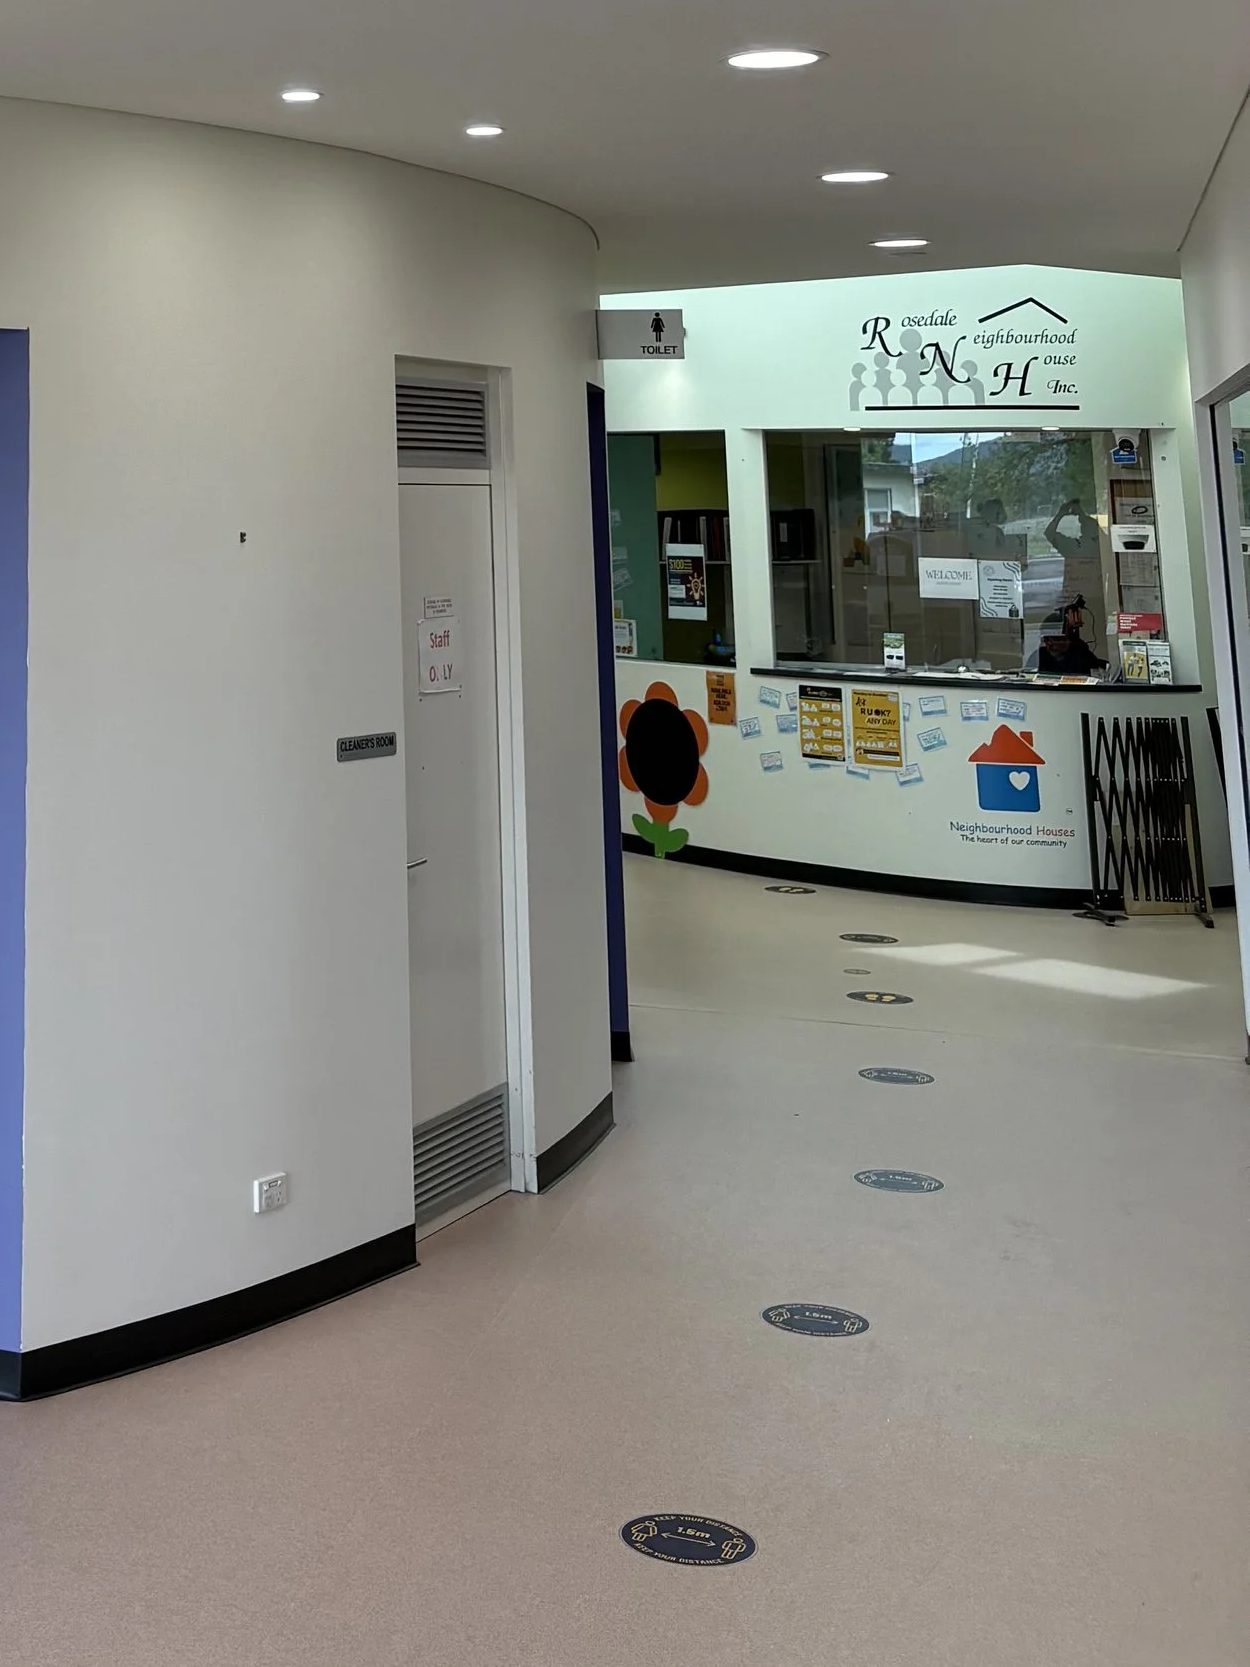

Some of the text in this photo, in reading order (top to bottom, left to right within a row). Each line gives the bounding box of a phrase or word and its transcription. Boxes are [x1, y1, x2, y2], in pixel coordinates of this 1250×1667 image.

[640, 345, 678, 355] TOILET
[1046, 379, 1079, 395] Inc.
[925, 569, 973, 581] WELCOME
[429, 629, 450, 649] Staff
[429, 663, 453, 682] OLY
[340, 735, 394, 752] CLEANER'S ROOM
[949, 821, 1076, 837] Neighbourhood Houses
[960, 834, 1068, 849] The heart of our community
[679, 1515, 705, 1523] YOUR
[676, 1526, 711, 1539] 1.5m
[678, 1557, 726, 1565] DISTANCE
